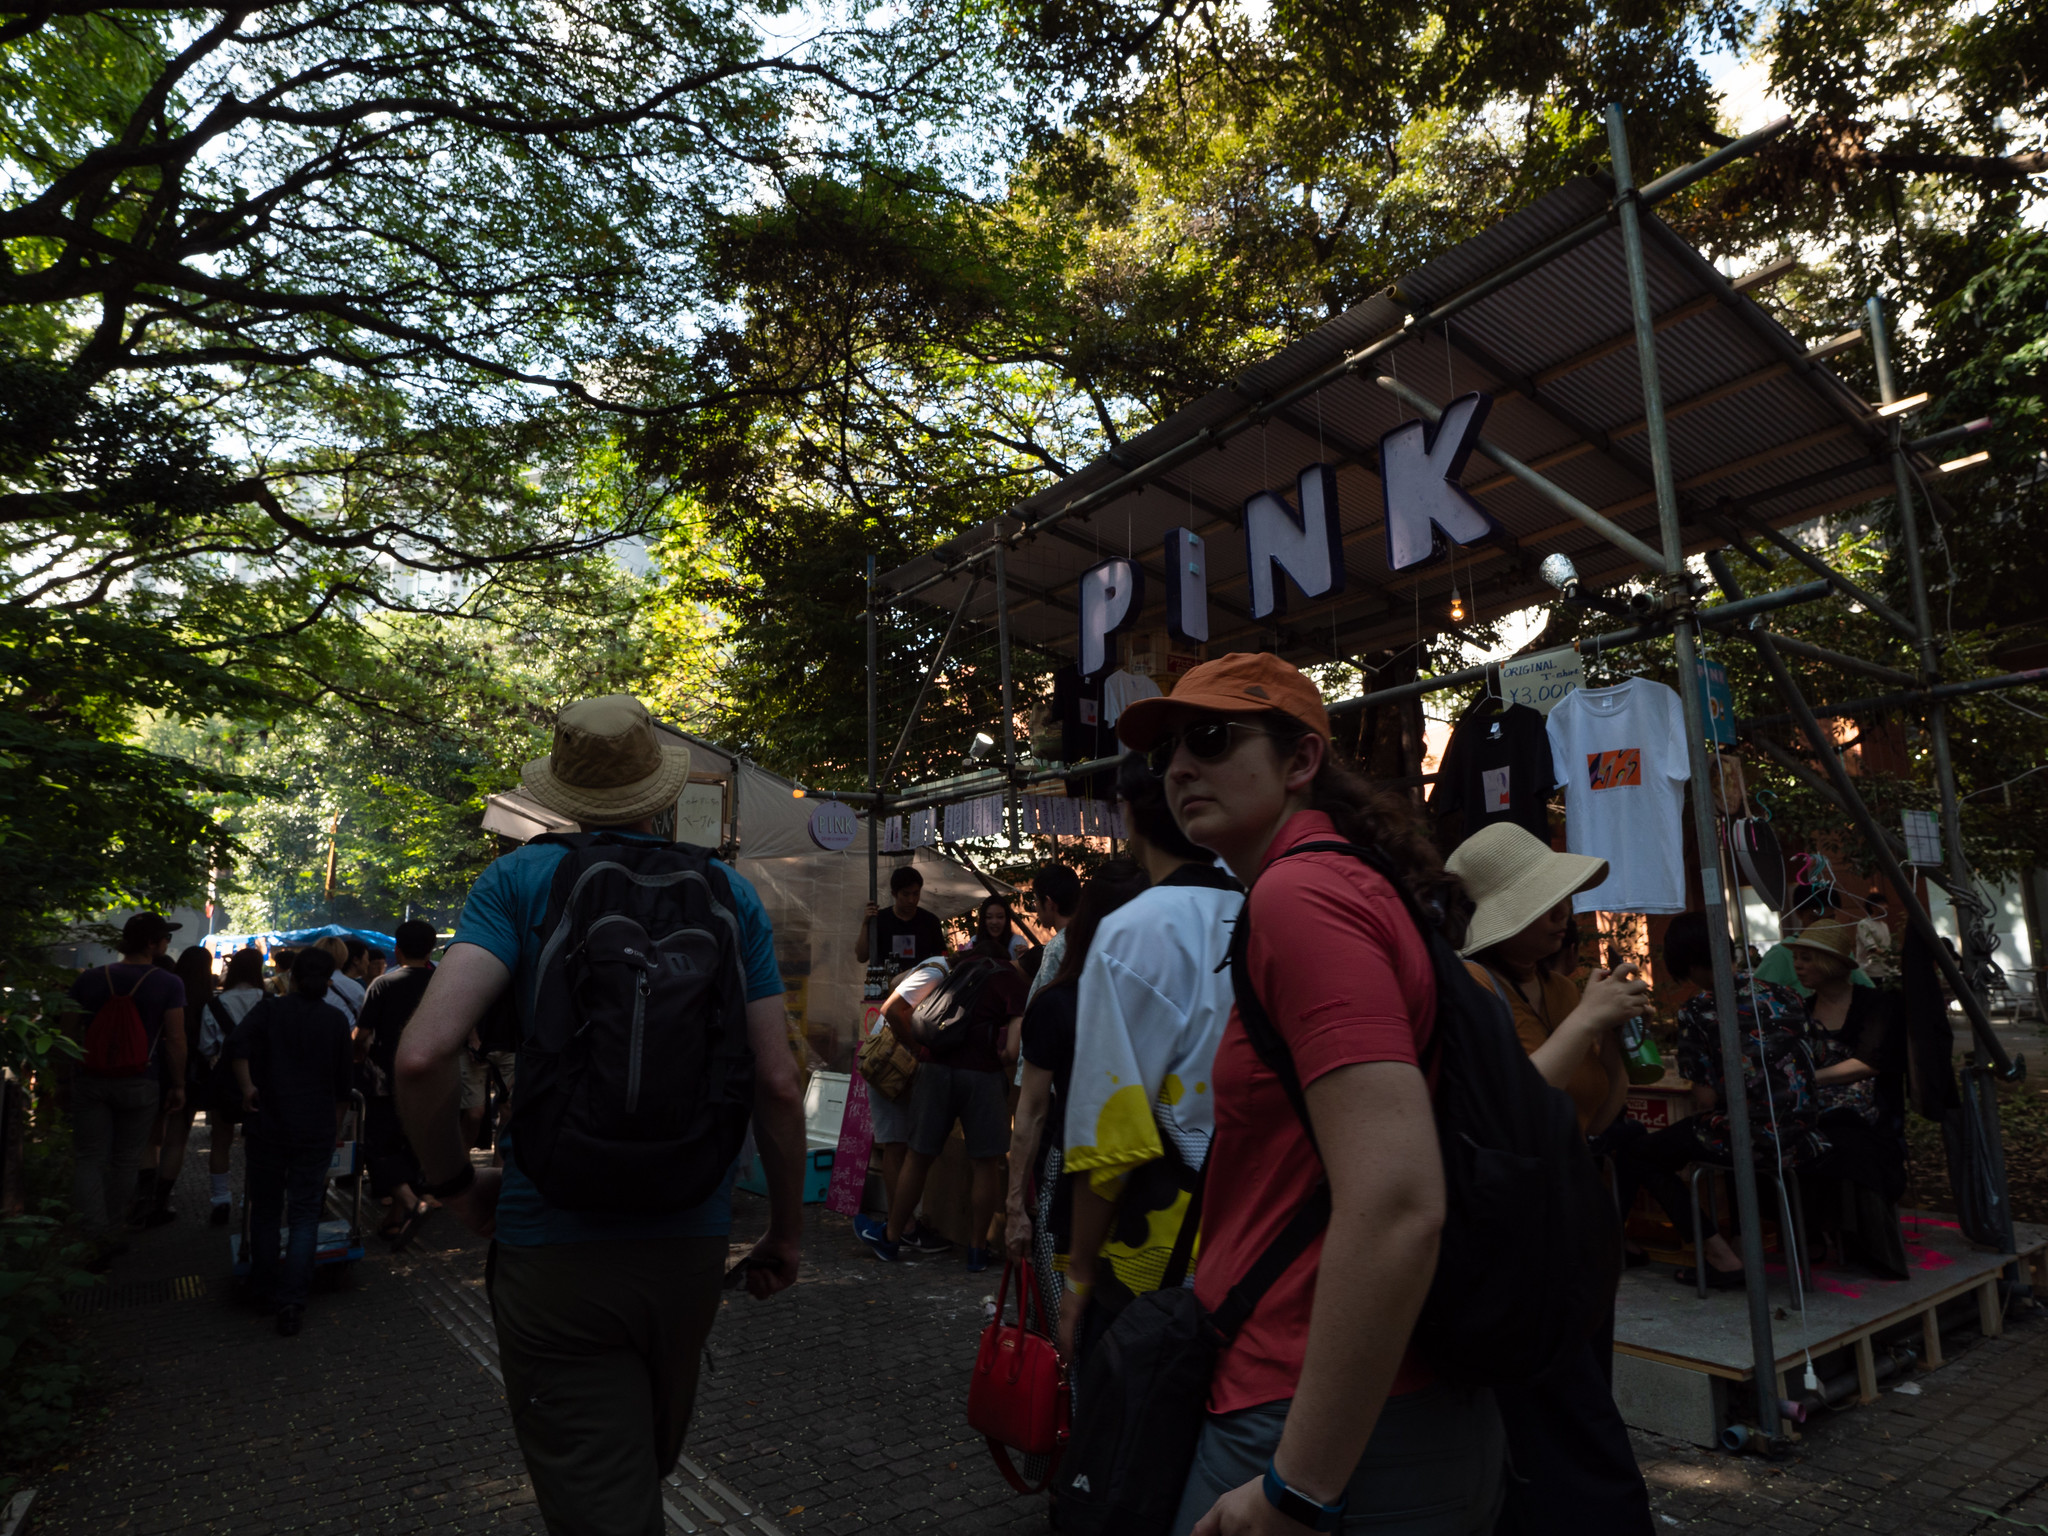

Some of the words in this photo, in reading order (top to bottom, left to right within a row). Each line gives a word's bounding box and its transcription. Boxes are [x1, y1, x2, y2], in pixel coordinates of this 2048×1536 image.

[1079, 391, 1507, 677] PINK
[1503, 660, 1557, 678] ORIGINAL
[818, 815, 853, 834] PINK
